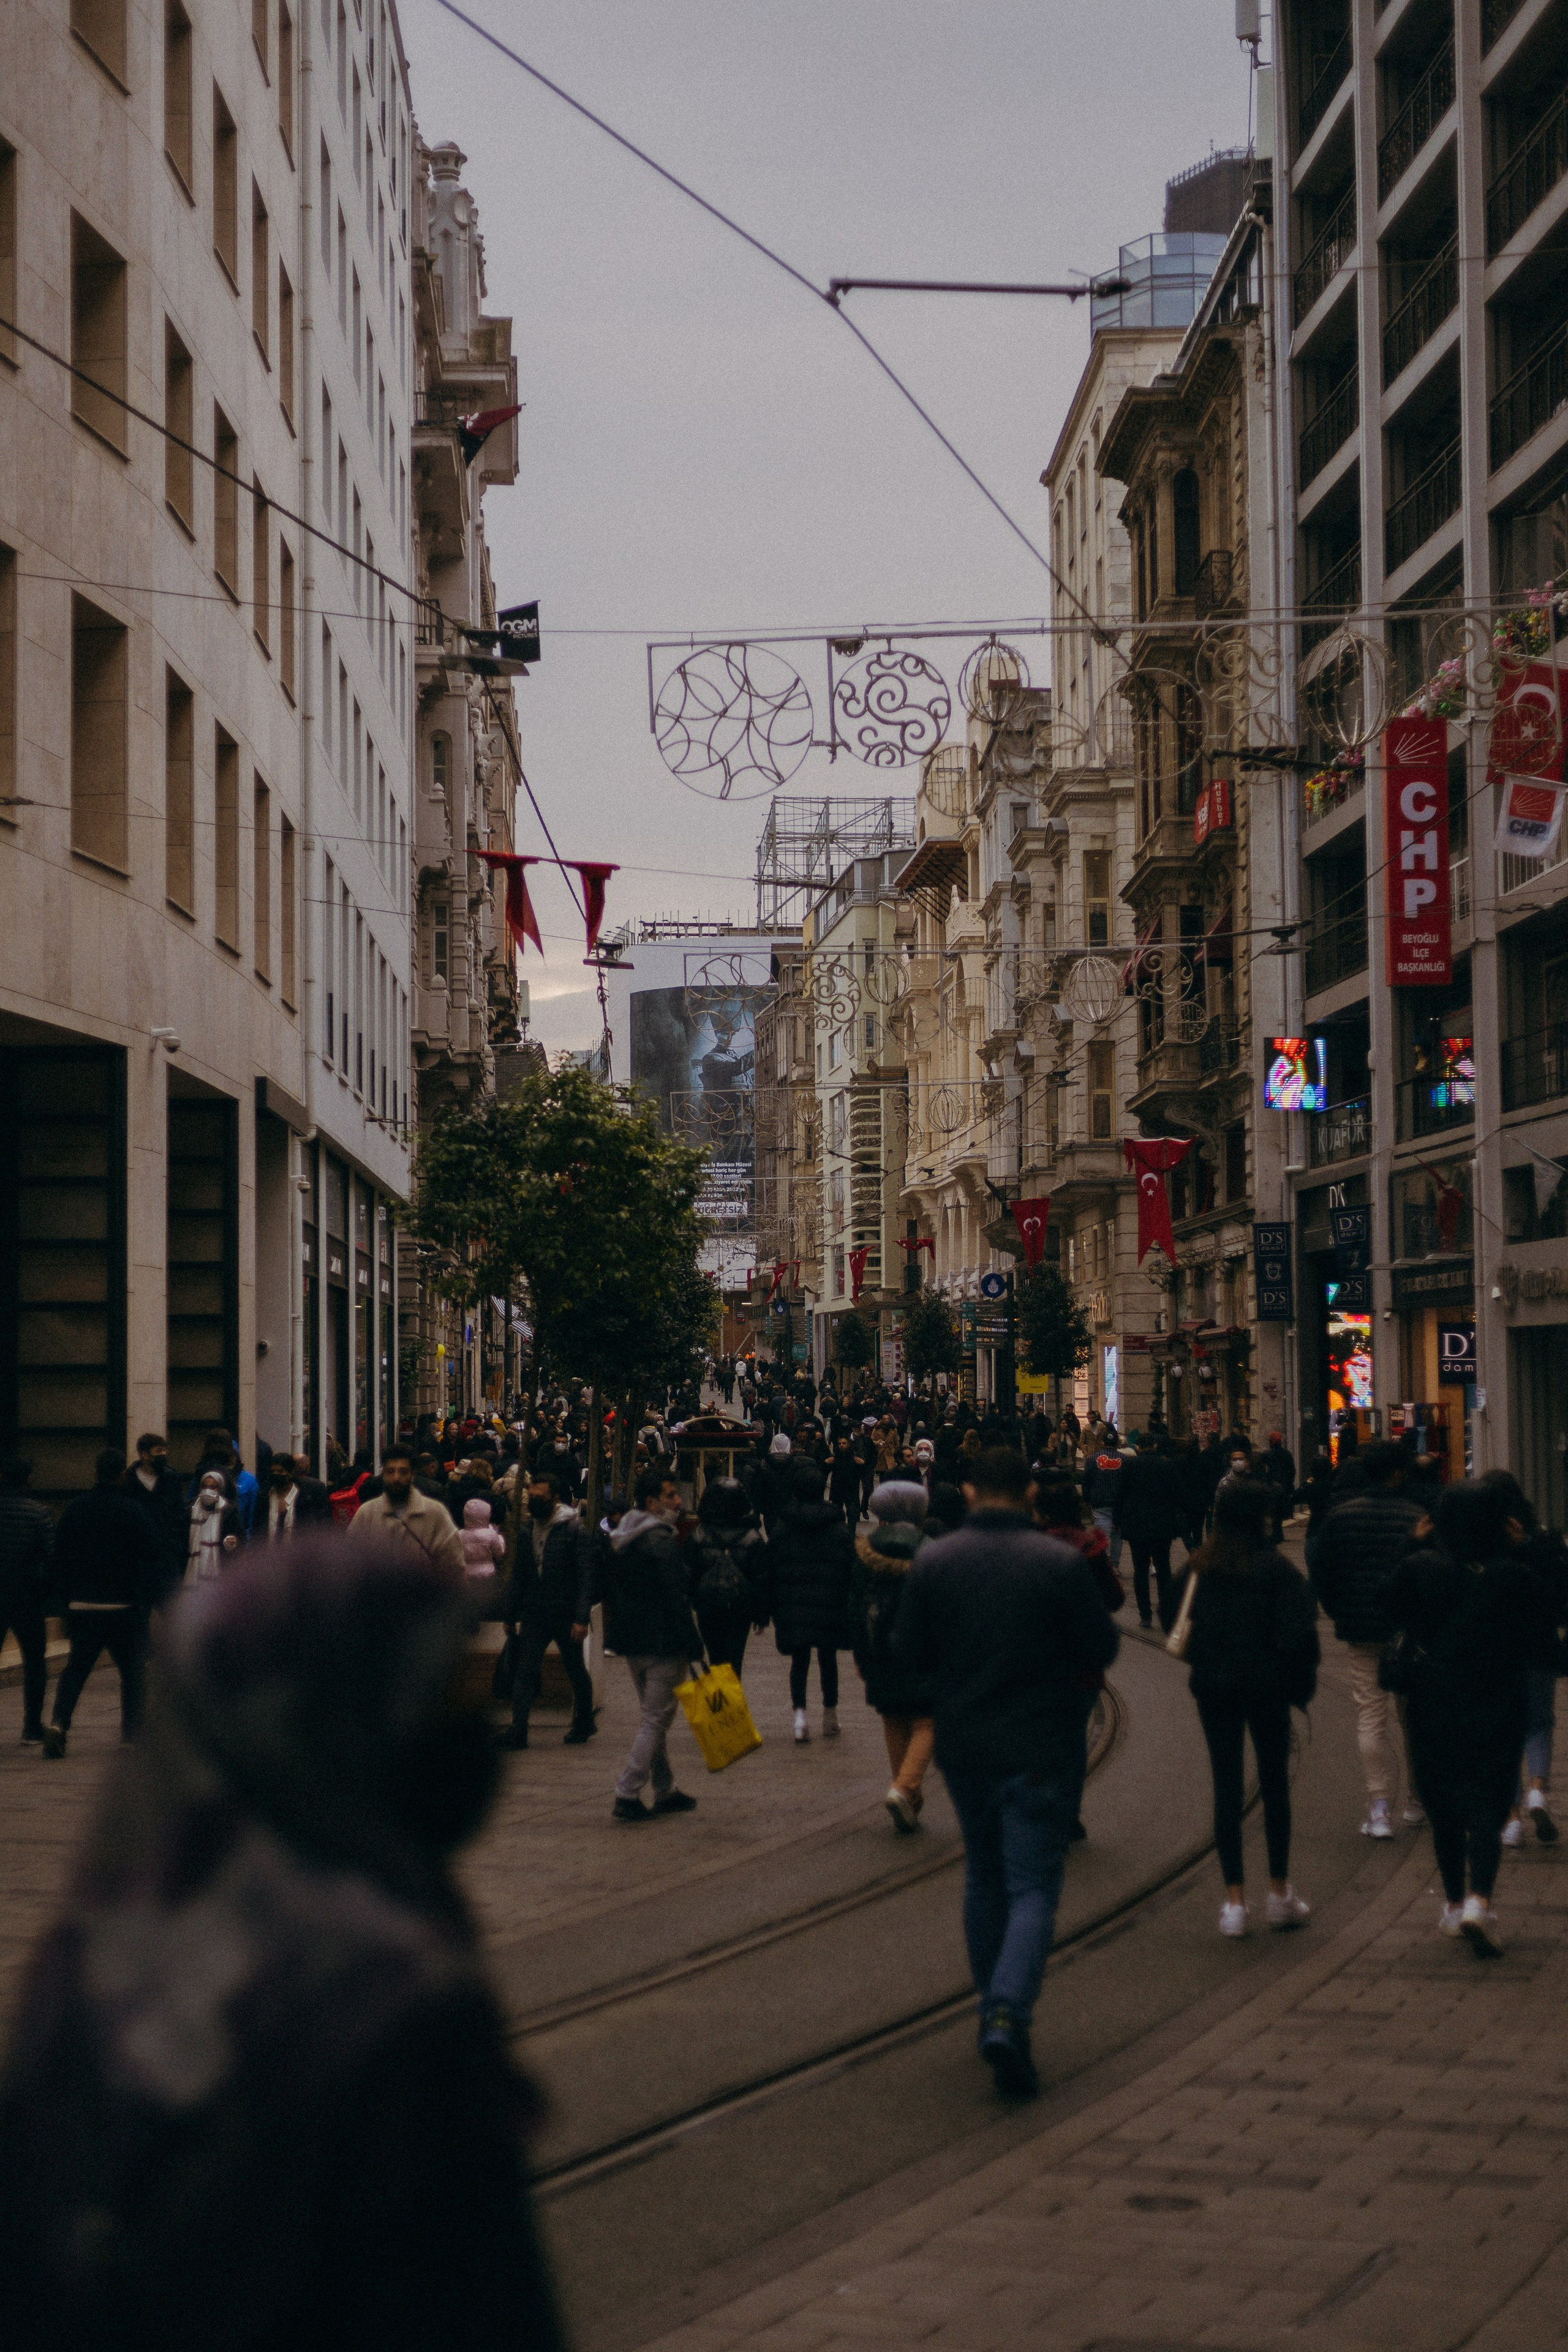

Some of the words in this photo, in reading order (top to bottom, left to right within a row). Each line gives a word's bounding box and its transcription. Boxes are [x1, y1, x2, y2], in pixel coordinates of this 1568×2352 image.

[1215, 782, 1223, 825] Hueber
[1509, 820, 1547, 837] CHP
[1400, 782, 1438, 918] CHP
[1403, 932, 1439, 943] BEYOĞLU
[1412, 946, 1430, 960] İLÇE
[1398, 960, 1446, 974] BAŞKANLIĞI
[1261, 1232, 1283, 1244] D'S
[1339, 1281, 1362, 1294] D'S
[1264, 1291, 1286, 1304] D'S
[1442, 1332, 1475, 1357] D'
[1443, 1362, 1474, 1372] dam
